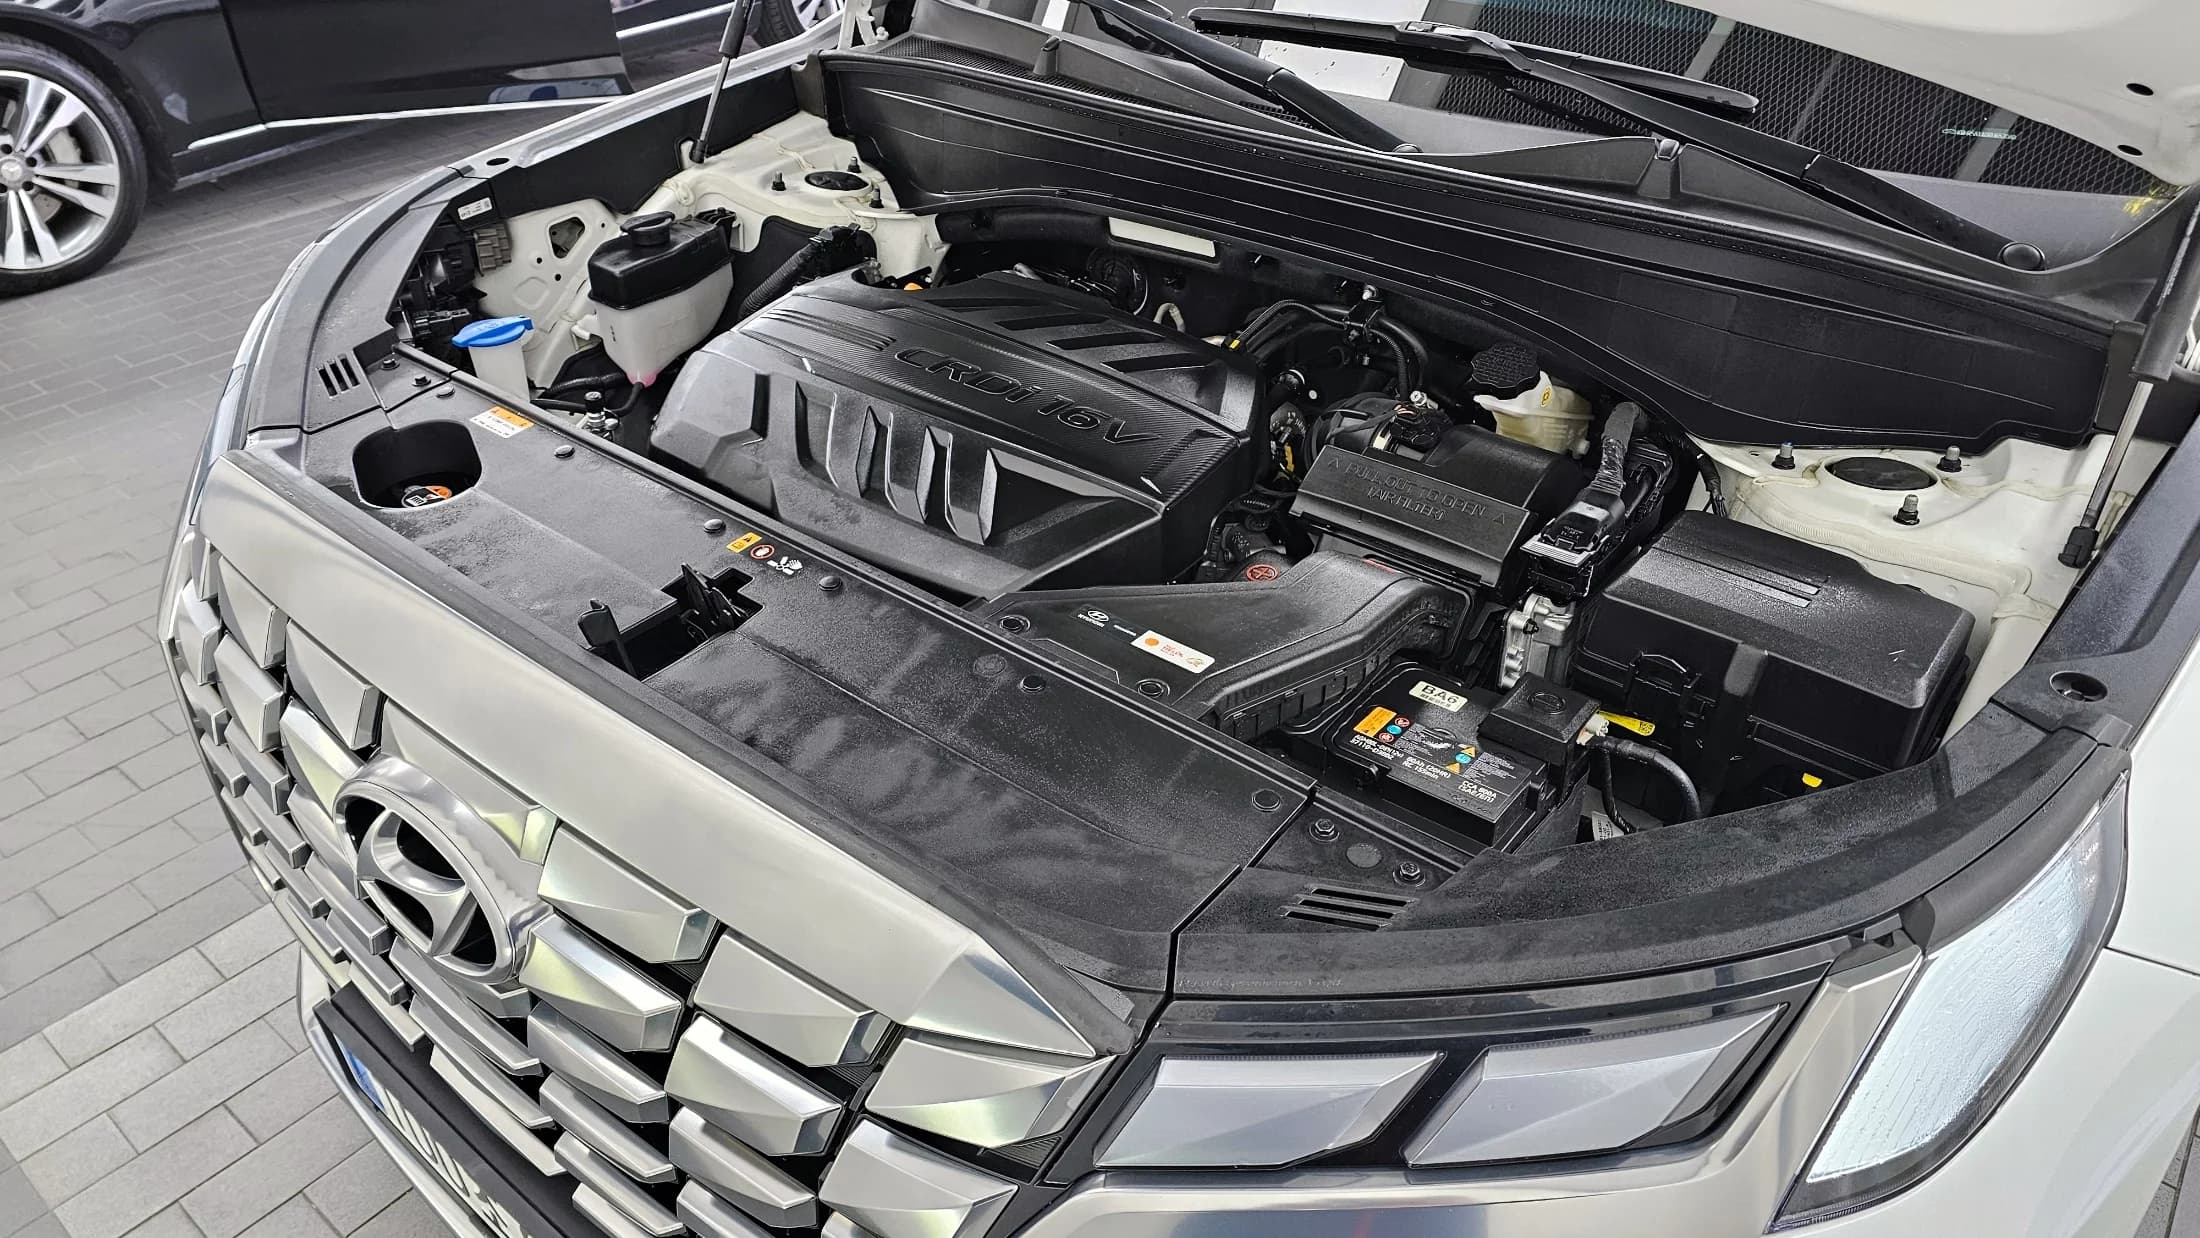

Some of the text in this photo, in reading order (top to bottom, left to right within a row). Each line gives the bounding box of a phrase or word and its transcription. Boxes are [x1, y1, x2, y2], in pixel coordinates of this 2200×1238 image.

[894, 349, 1163, 443] CRDi 16V
[1345, 462, 1488, 517] PULL OUT TO OPEN
[1422, 685, 1459, 703] BA6
